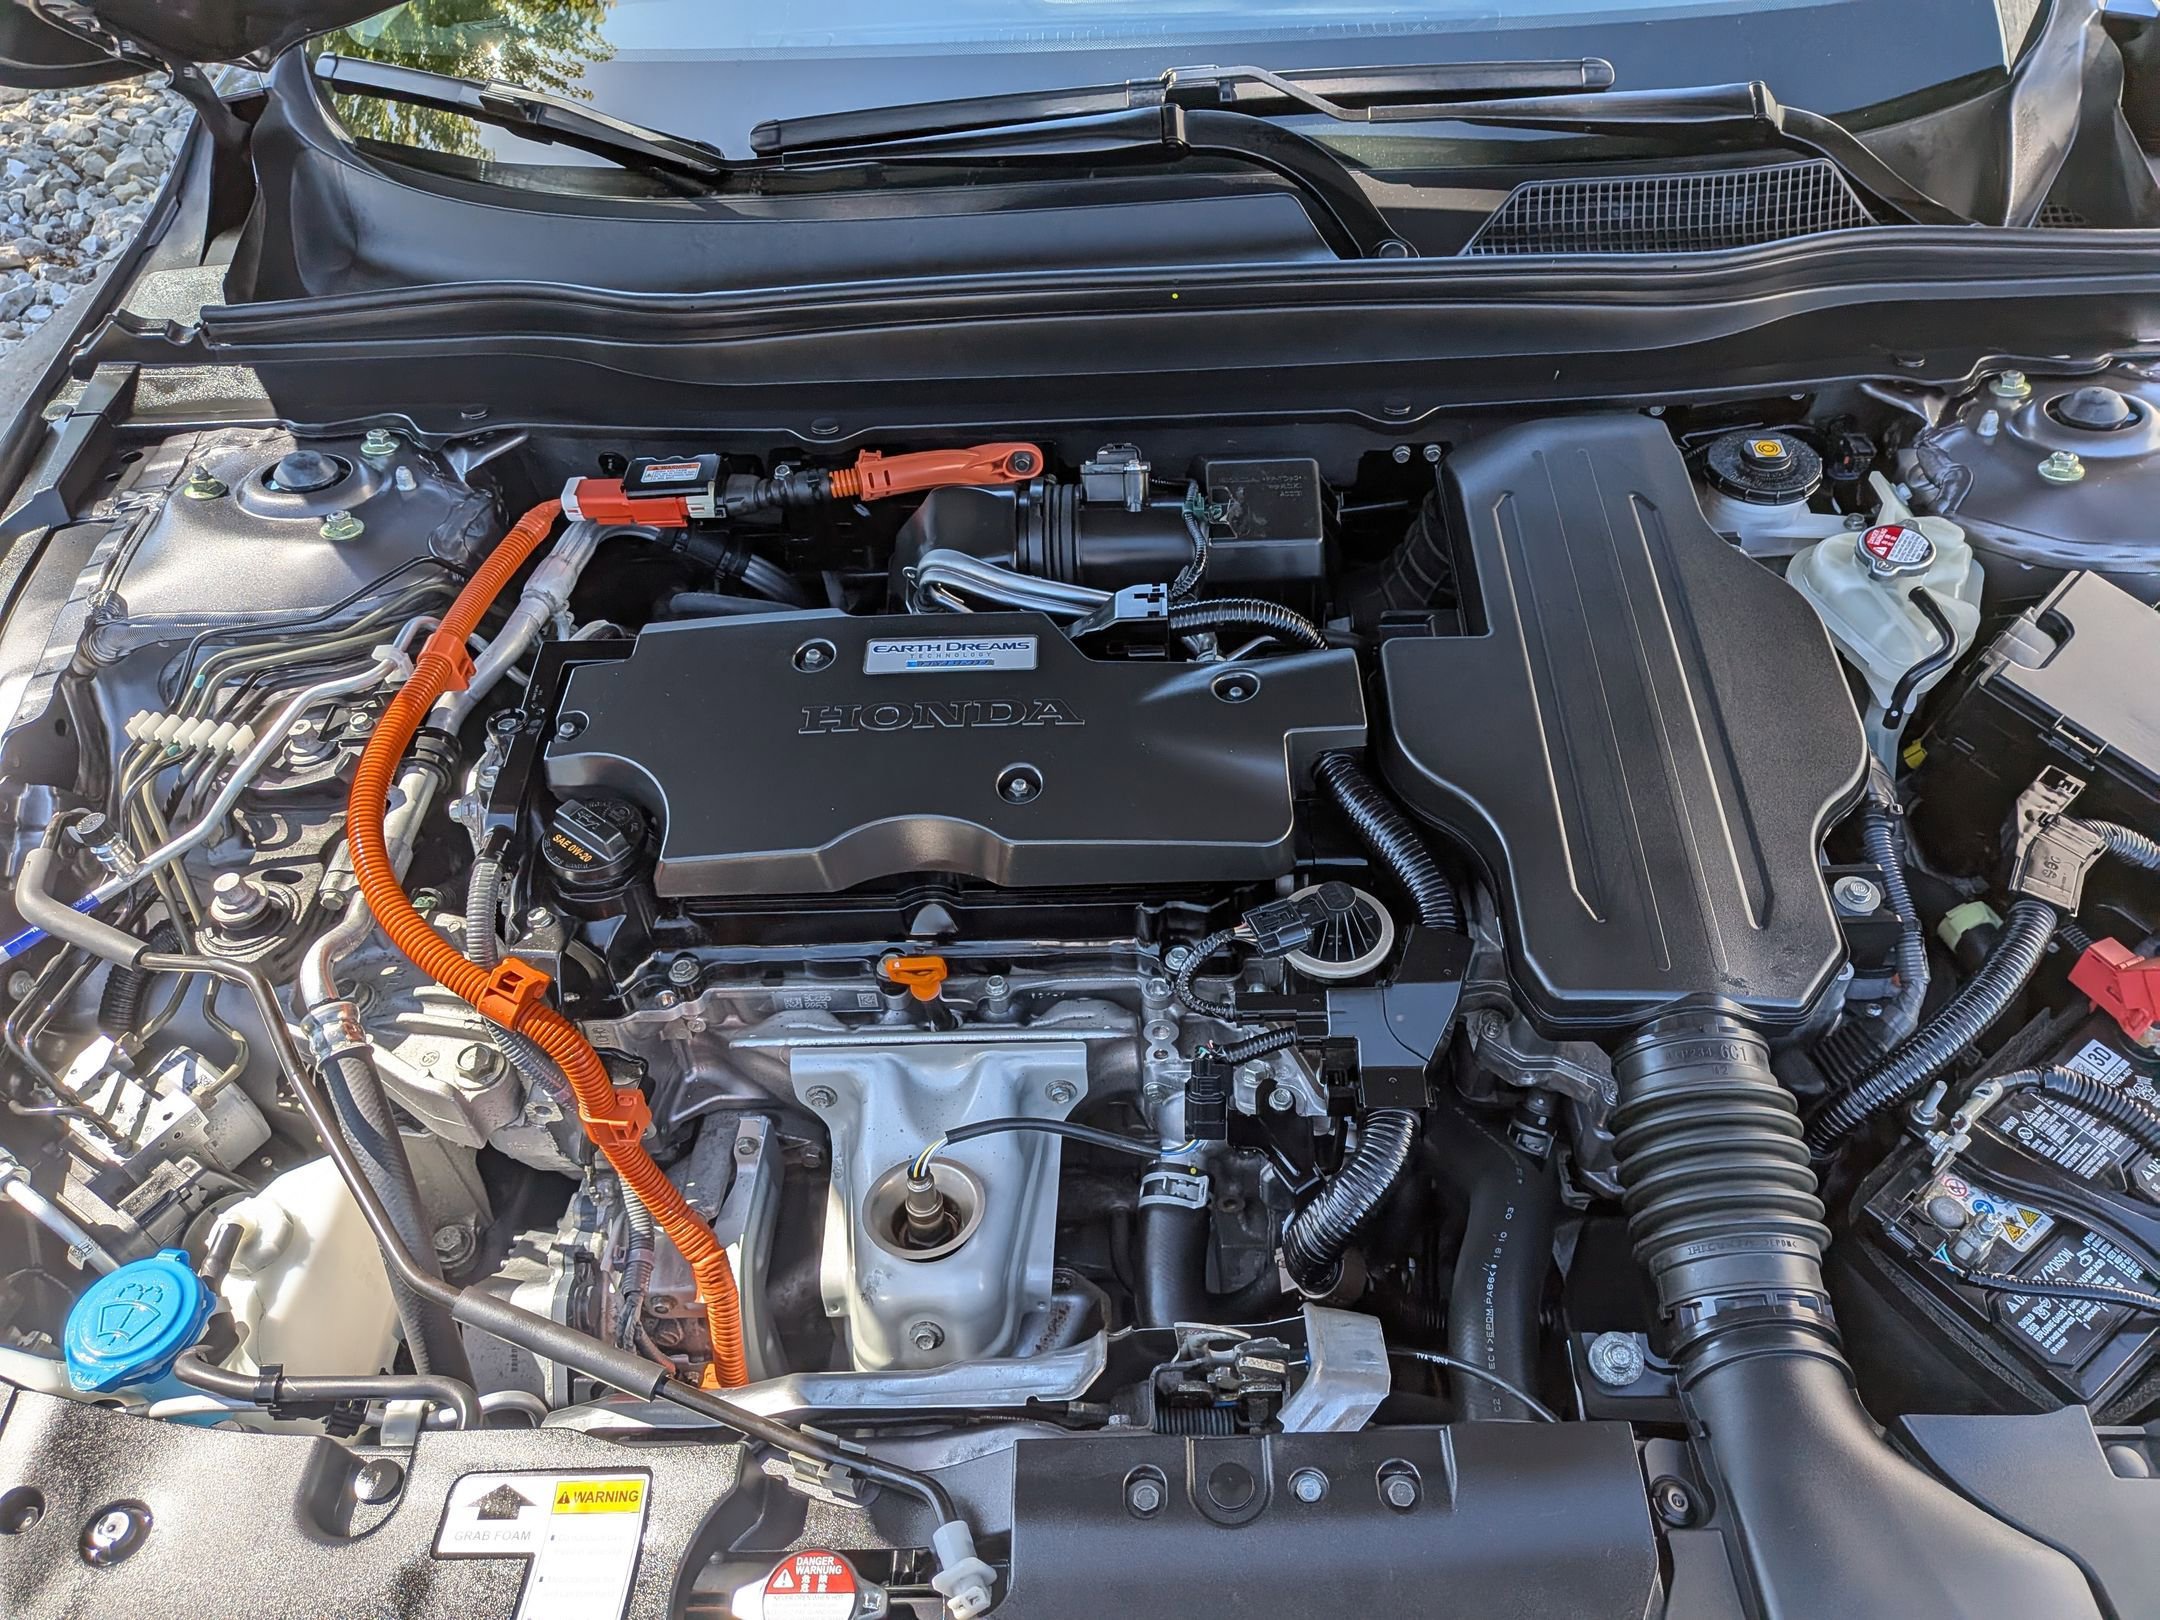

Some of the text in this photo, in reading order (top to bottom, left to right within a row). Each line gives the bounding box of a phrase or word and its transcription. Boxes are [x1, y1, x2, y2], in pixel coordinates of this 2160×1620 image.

[873, 642, 1030, 653] EARTH DREAMS
[798, 698, 1085, 734] HONDA
[552, 834, 571, 848] SAE
[567, 844, 593, 863] 0W-20
[1720, 1044, 1748, 1062] 6C1
[2087, 1046, 2112, 1067] 3D
[1488, 1355, 1495, 1370] EC
[1494, 1247, 1502, 1258] 19
[1505, 1207, 1514, 1220] 03
[574, 1490, 639, 1503] WARNING
[454, 1530, 531, 1541] GRAB FOAM
[796, 1557, 834, 1566] DANGER
[795, 1565, 842, 1575] WARNUNG
